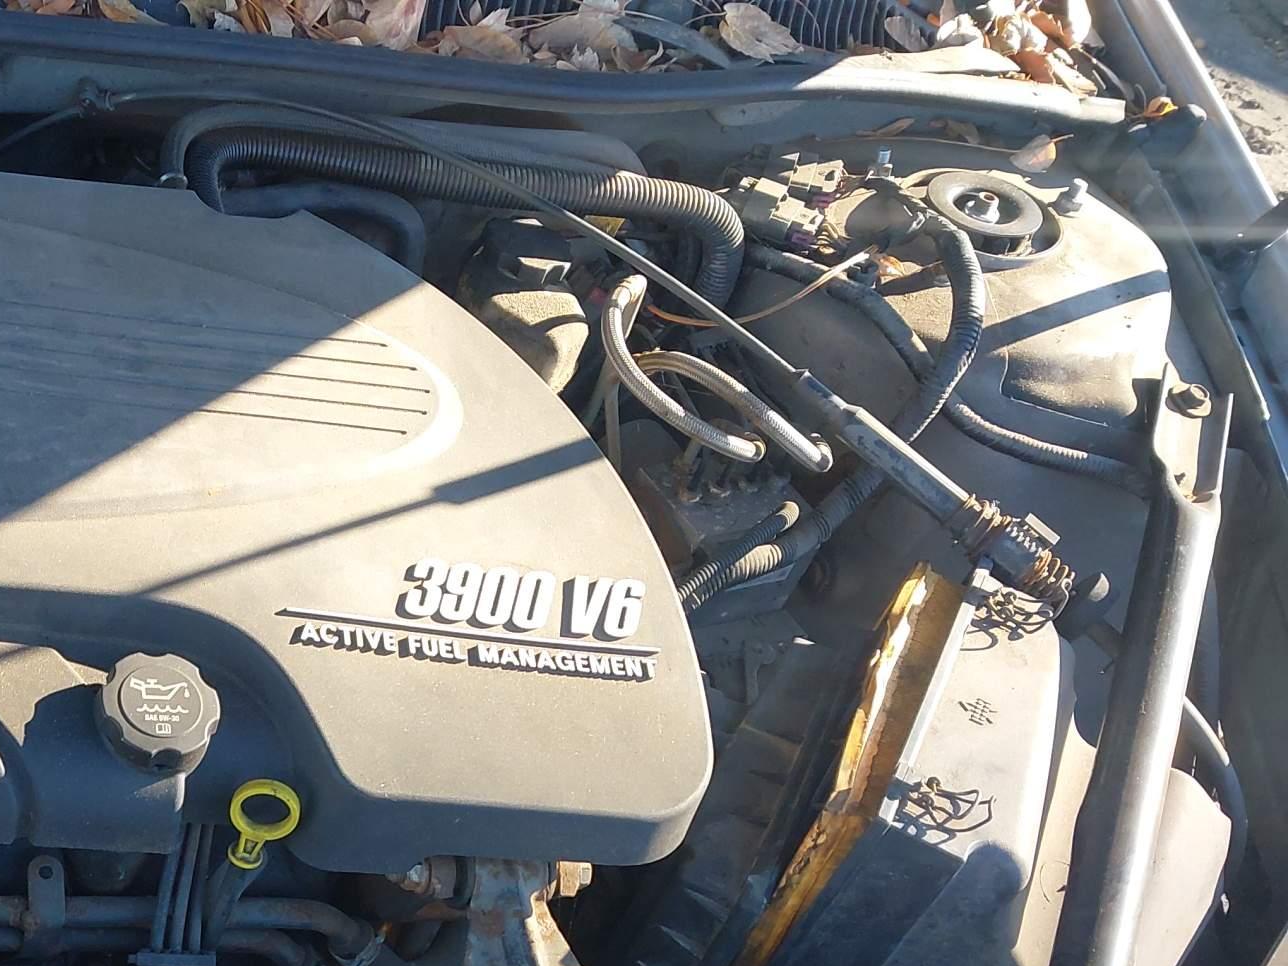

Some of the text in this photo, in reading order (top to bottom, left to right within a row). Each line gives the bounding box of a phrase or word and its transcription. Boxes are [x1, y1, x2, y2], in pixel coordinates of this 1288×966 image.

[396, 557, 646, 641] 3900 V6
[289, 621, 657, 683] ACTIVE FUEL MANAGEMENT
